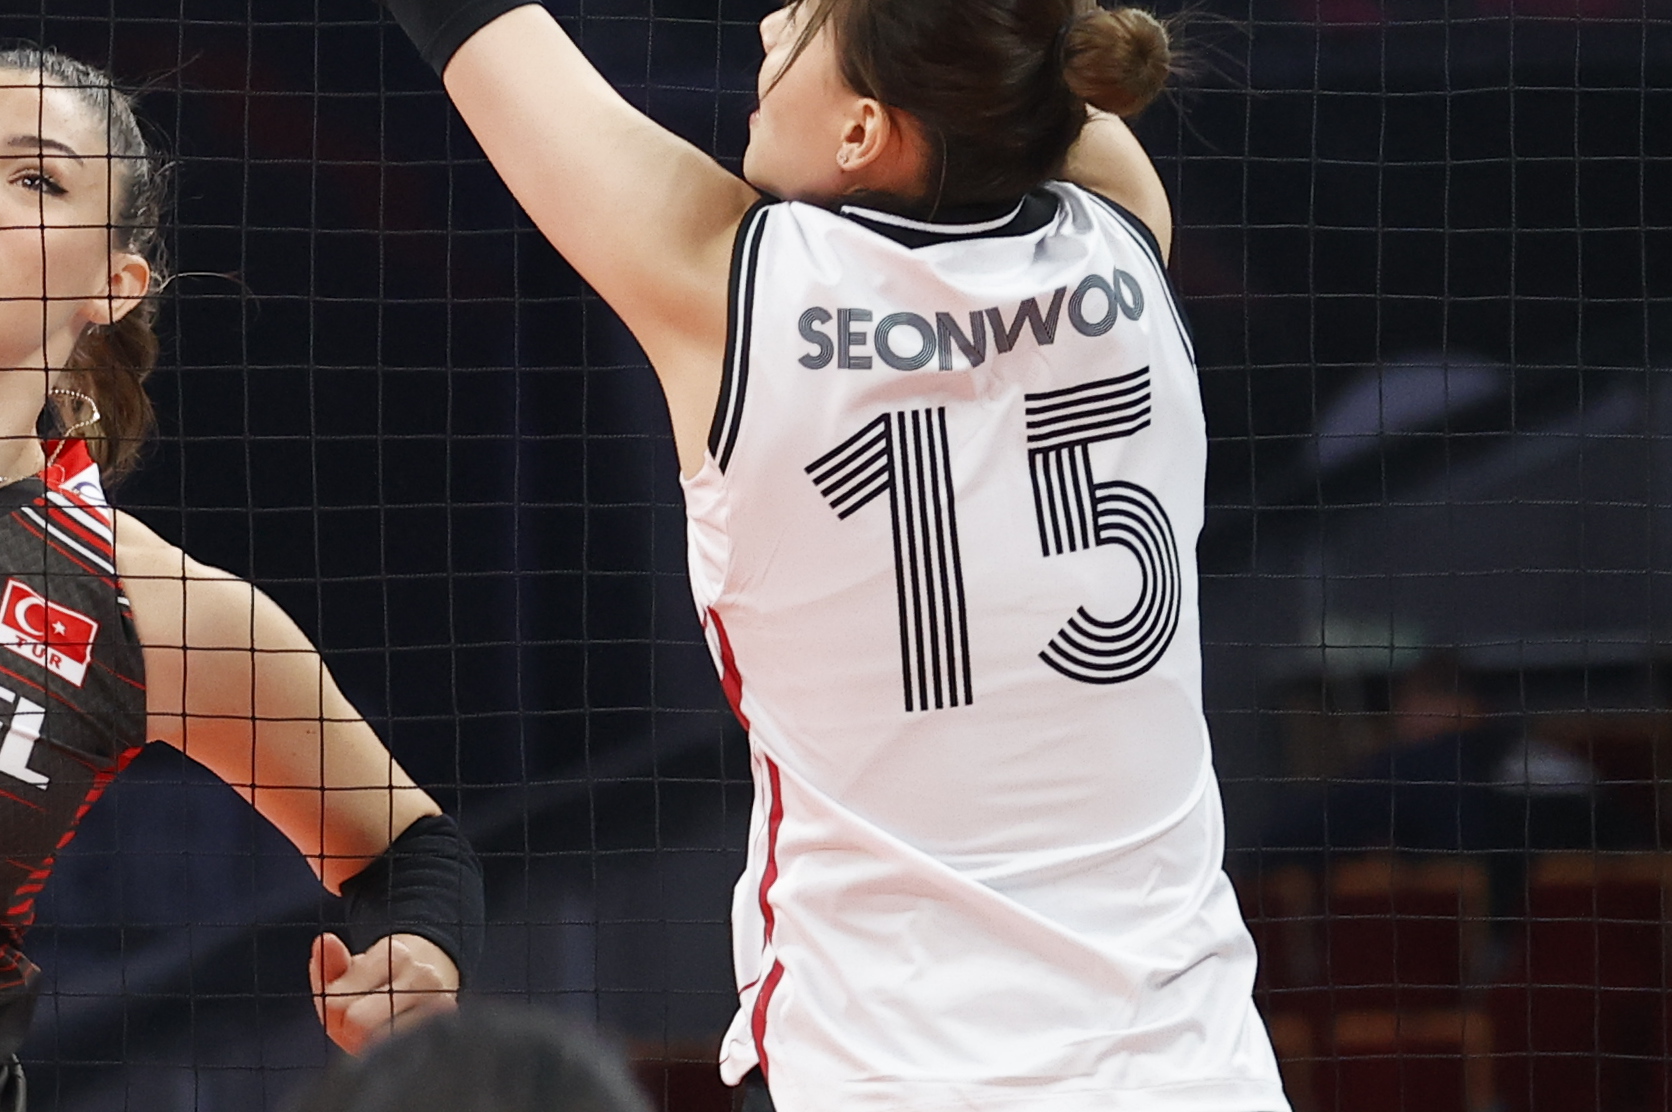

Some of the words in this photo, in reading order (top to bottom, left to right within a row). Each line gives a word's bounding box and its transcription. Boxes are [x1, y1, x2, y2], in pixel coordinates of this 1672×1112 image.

[798, 268, 1145, 372] SEONWOO
[804, 365, 1182, 712] 15
[15, 634, 63, 671] TUR
